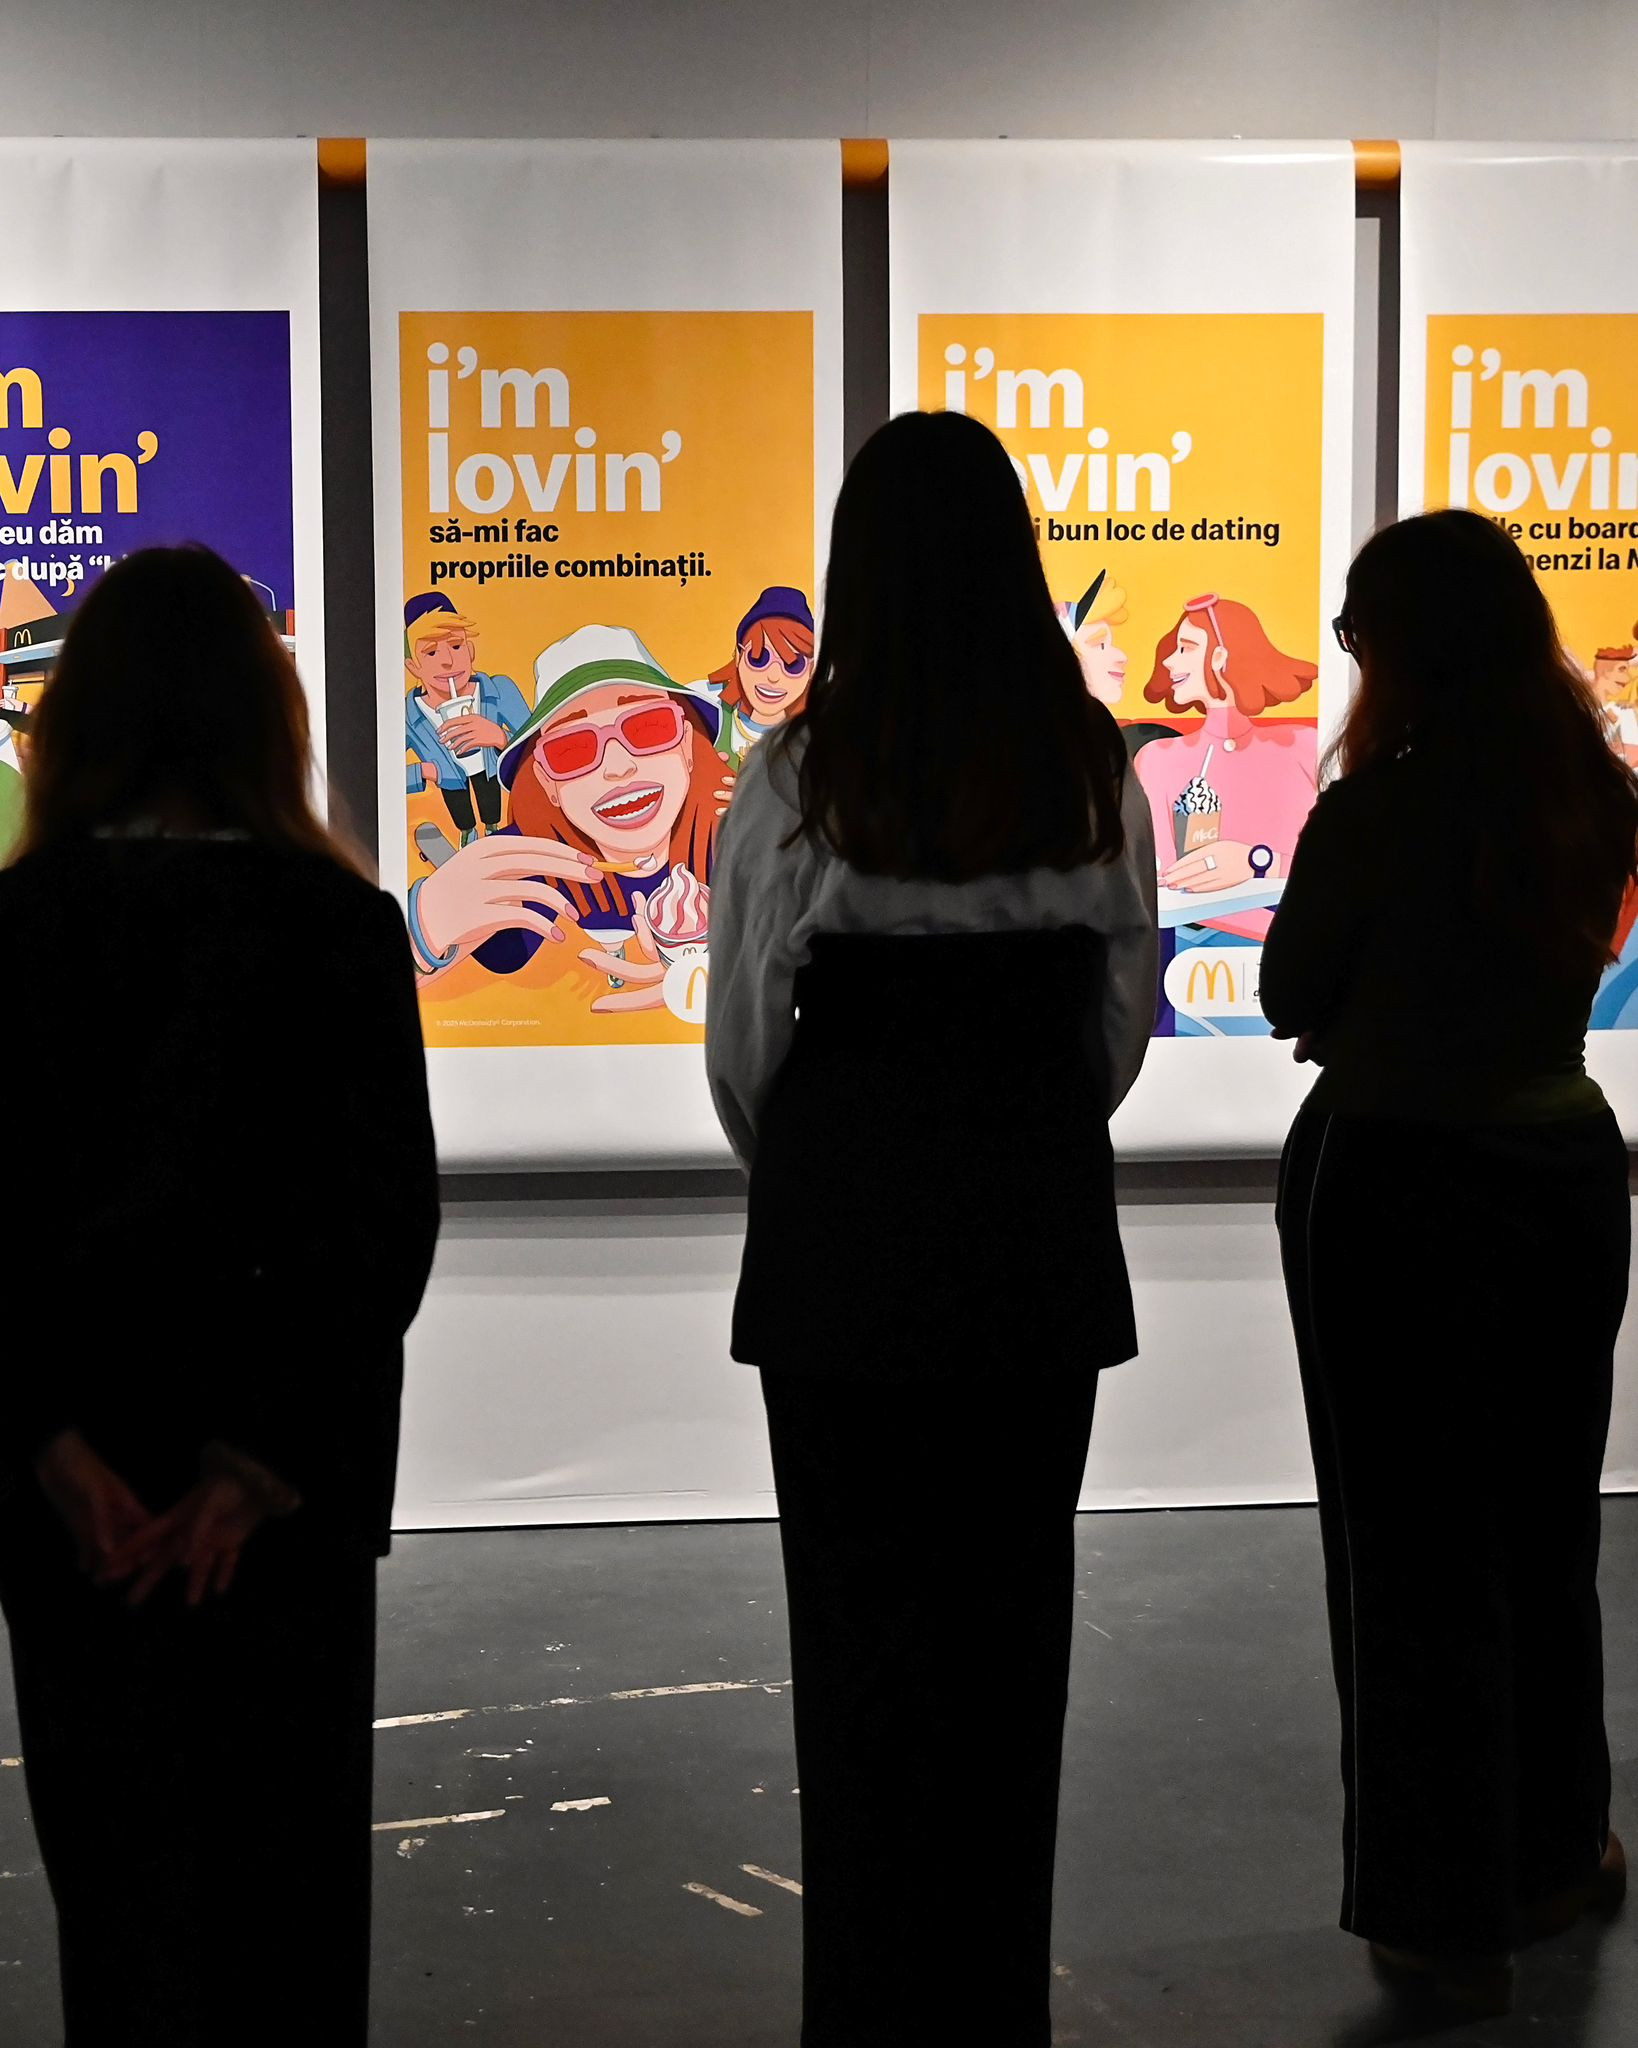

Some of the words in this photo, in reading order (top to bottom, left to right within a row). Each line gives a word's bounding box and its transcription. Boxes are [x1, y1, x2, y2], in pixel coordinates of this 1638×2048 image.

[427, 342, 570, 428] i’m
[944, 343, 1084, 428] i’m
[1452, 344, 1588, 429] i’m
[427, 427, 682, 514] lovin’
[1009, 427, 1192, 512] vin’
[39, 518, 103, 545] dăm
[429, 518, 508, 543] să-mi
[514, 518, 559, 543] fac
[1048, 518, 1099, 541] bun
[1106, 518, 1146, 541] loc
[1152, 518, 1185, 541] de
[1191, 516, 1280, 547] dating
[1529, 523, 1561, 540] cu
[12, 554, 84, 587] după
[430, 553, 549, 585] propriile
[555, 552, 712, 587] combinații.
[1598, 548, 1620, 570] la
